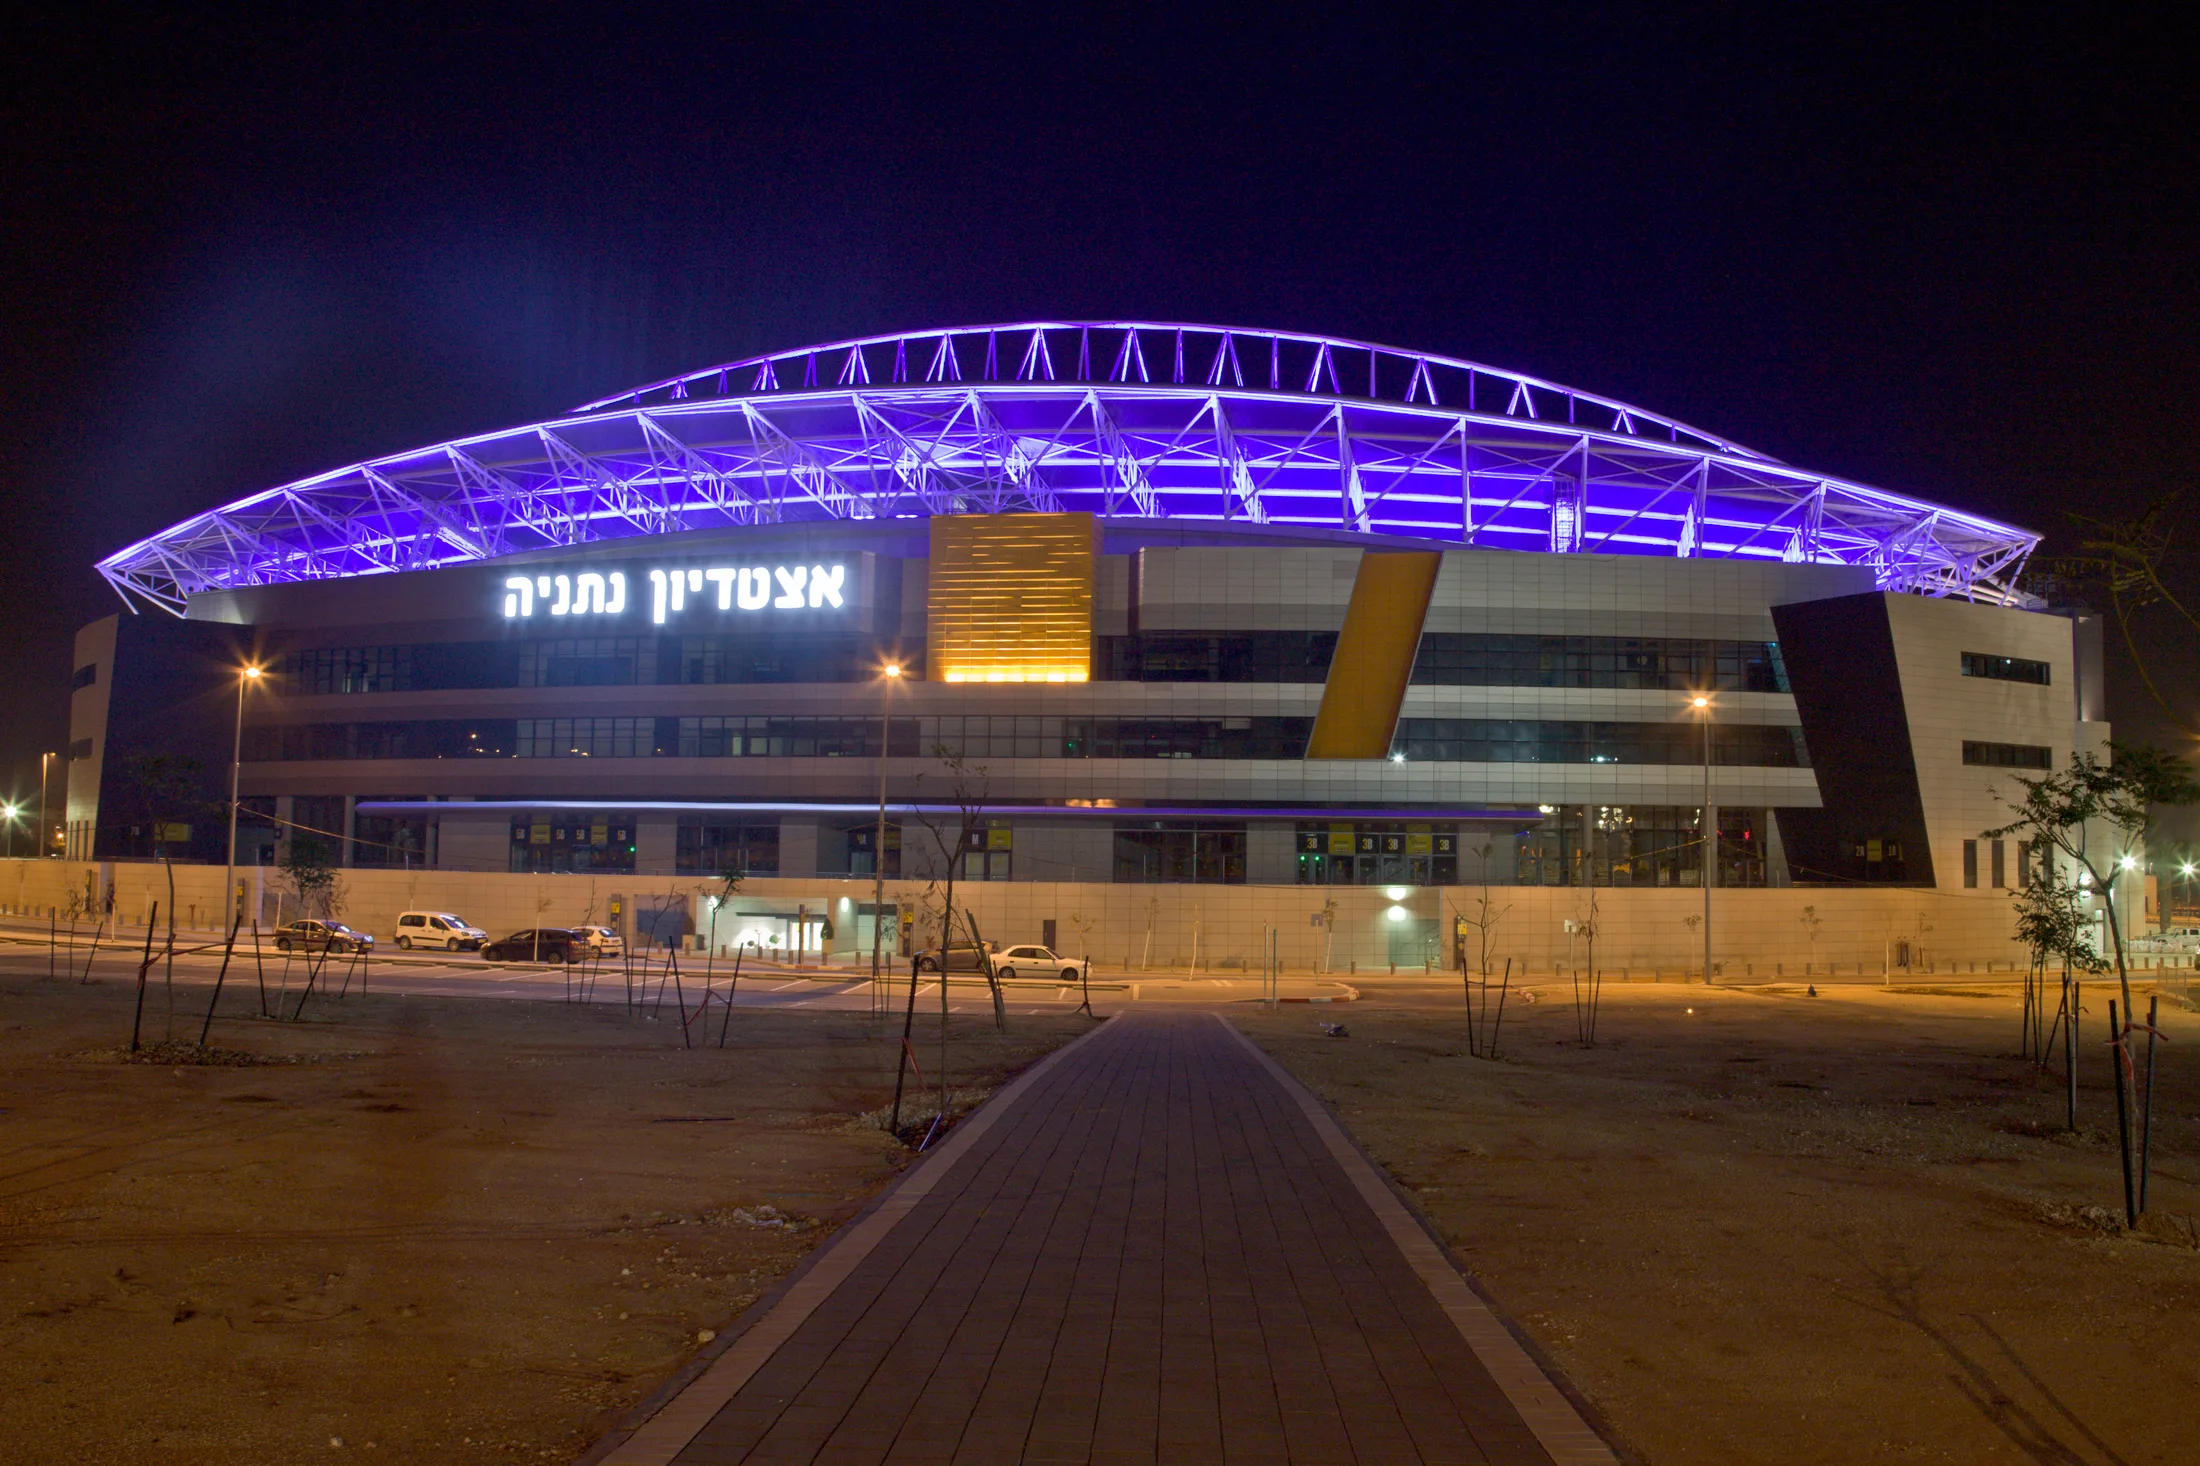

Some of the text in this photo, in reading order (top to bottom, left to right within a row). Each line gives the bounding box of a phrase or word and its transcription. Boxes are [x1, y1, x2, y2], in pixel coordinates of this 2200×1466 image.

[504, 564, 846, 624] אצטדיון נתניה
[1306, 837, 1318, 849] 3B
[1361, 838, 1373, 850] 3B
[1387, 838, 1399, 850] 3B
[1439, 839, 1450, 851] 3B
